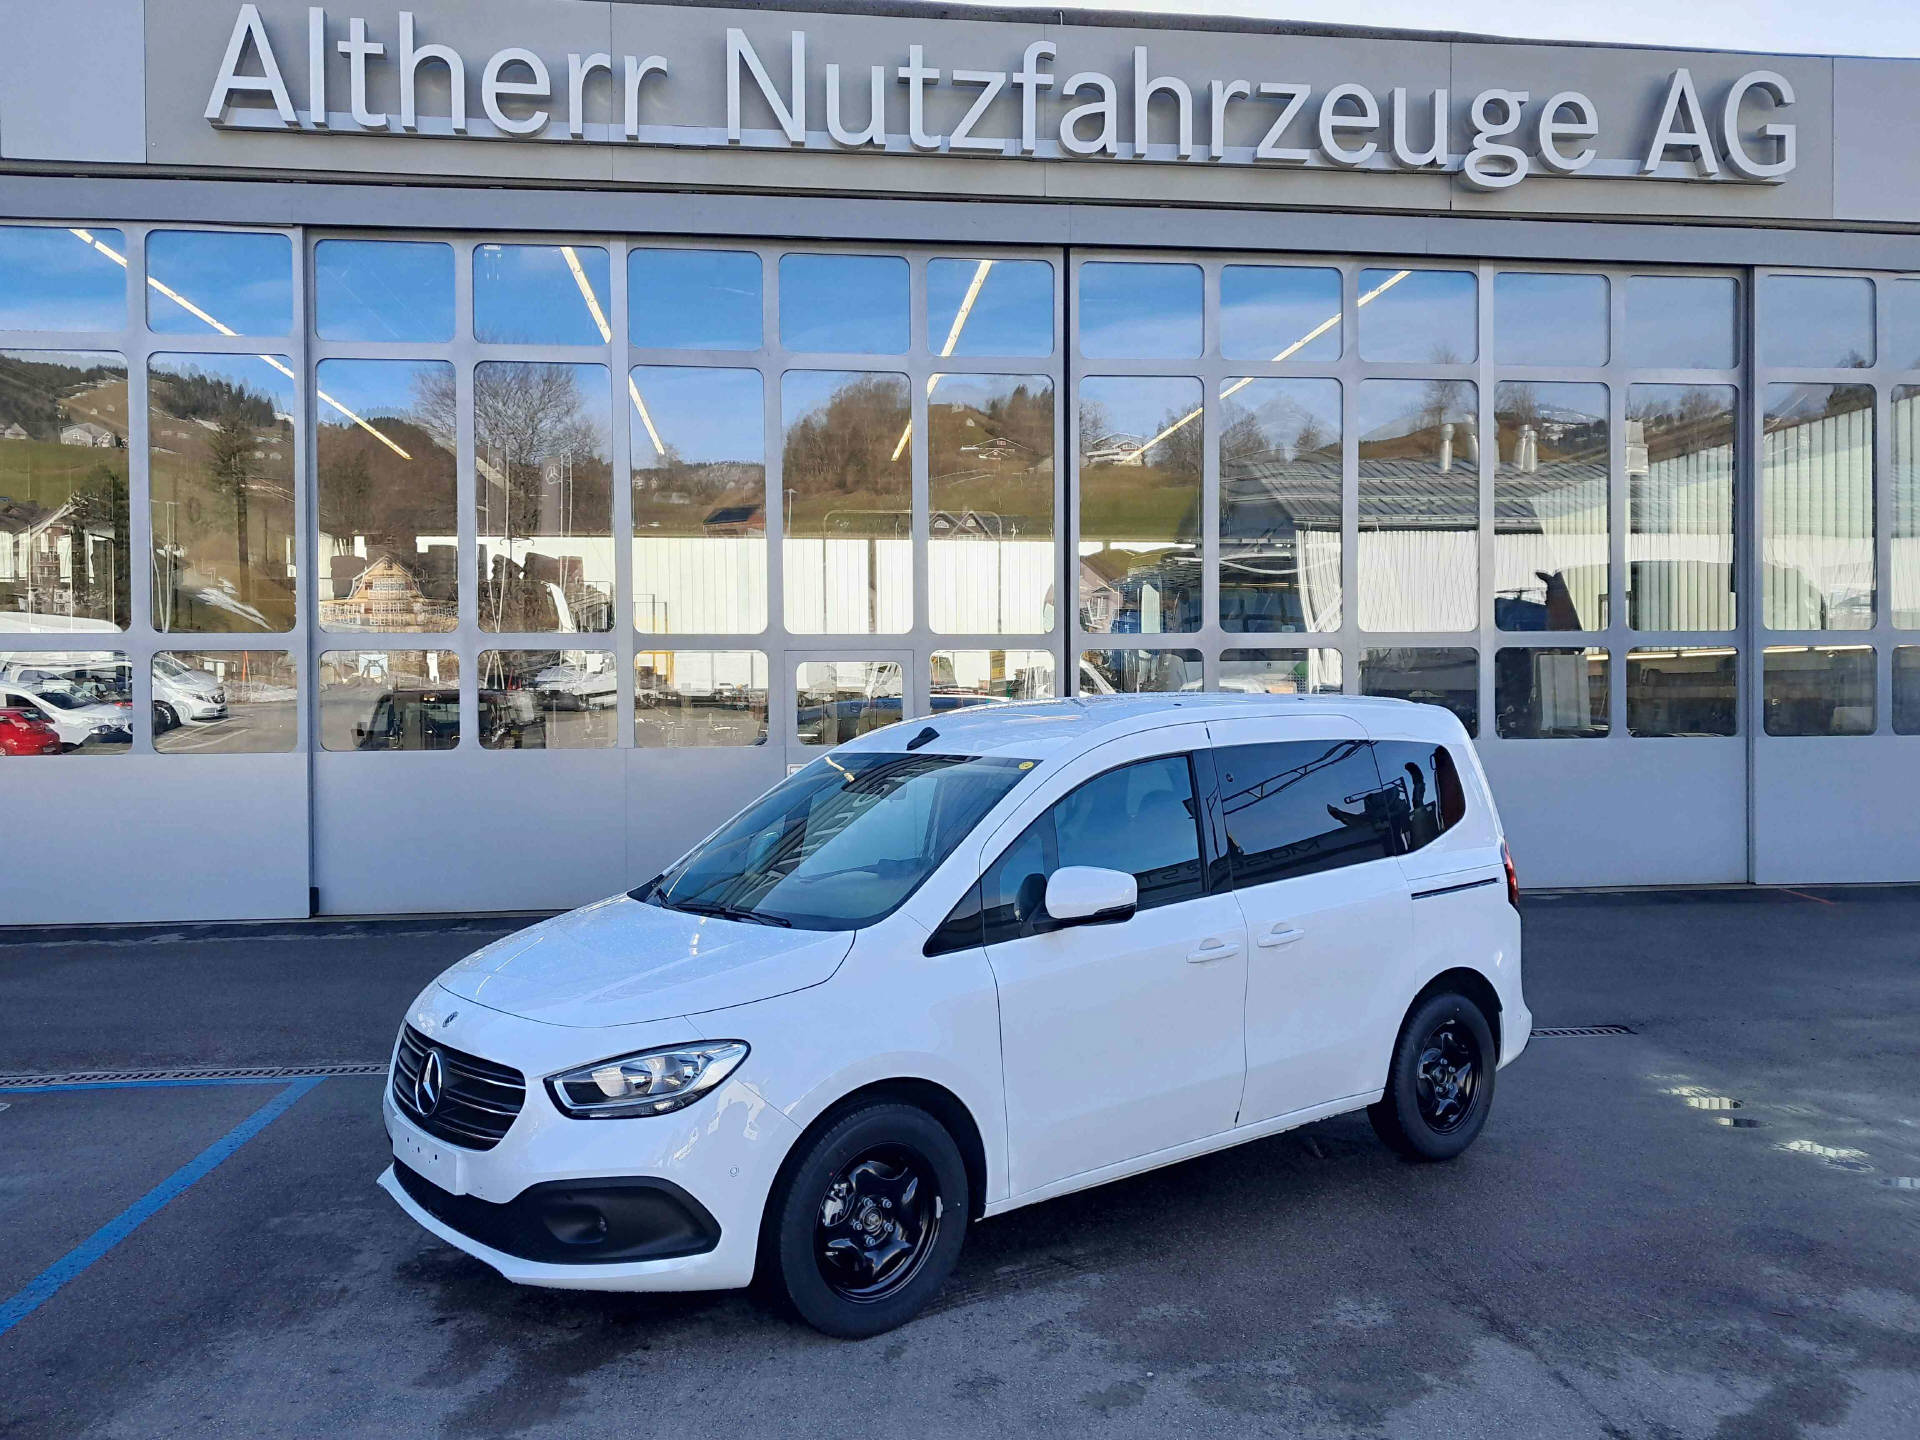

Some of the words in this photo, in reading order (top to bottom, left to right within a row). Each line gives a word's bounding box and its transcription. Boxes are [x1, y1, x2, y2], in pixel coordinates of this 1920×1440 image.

[203, 3, 668, 140] Altherr
[726, 27, 1599, 192] Nutzfahrzeuge
[1639, 67, 1797, 183] AG
